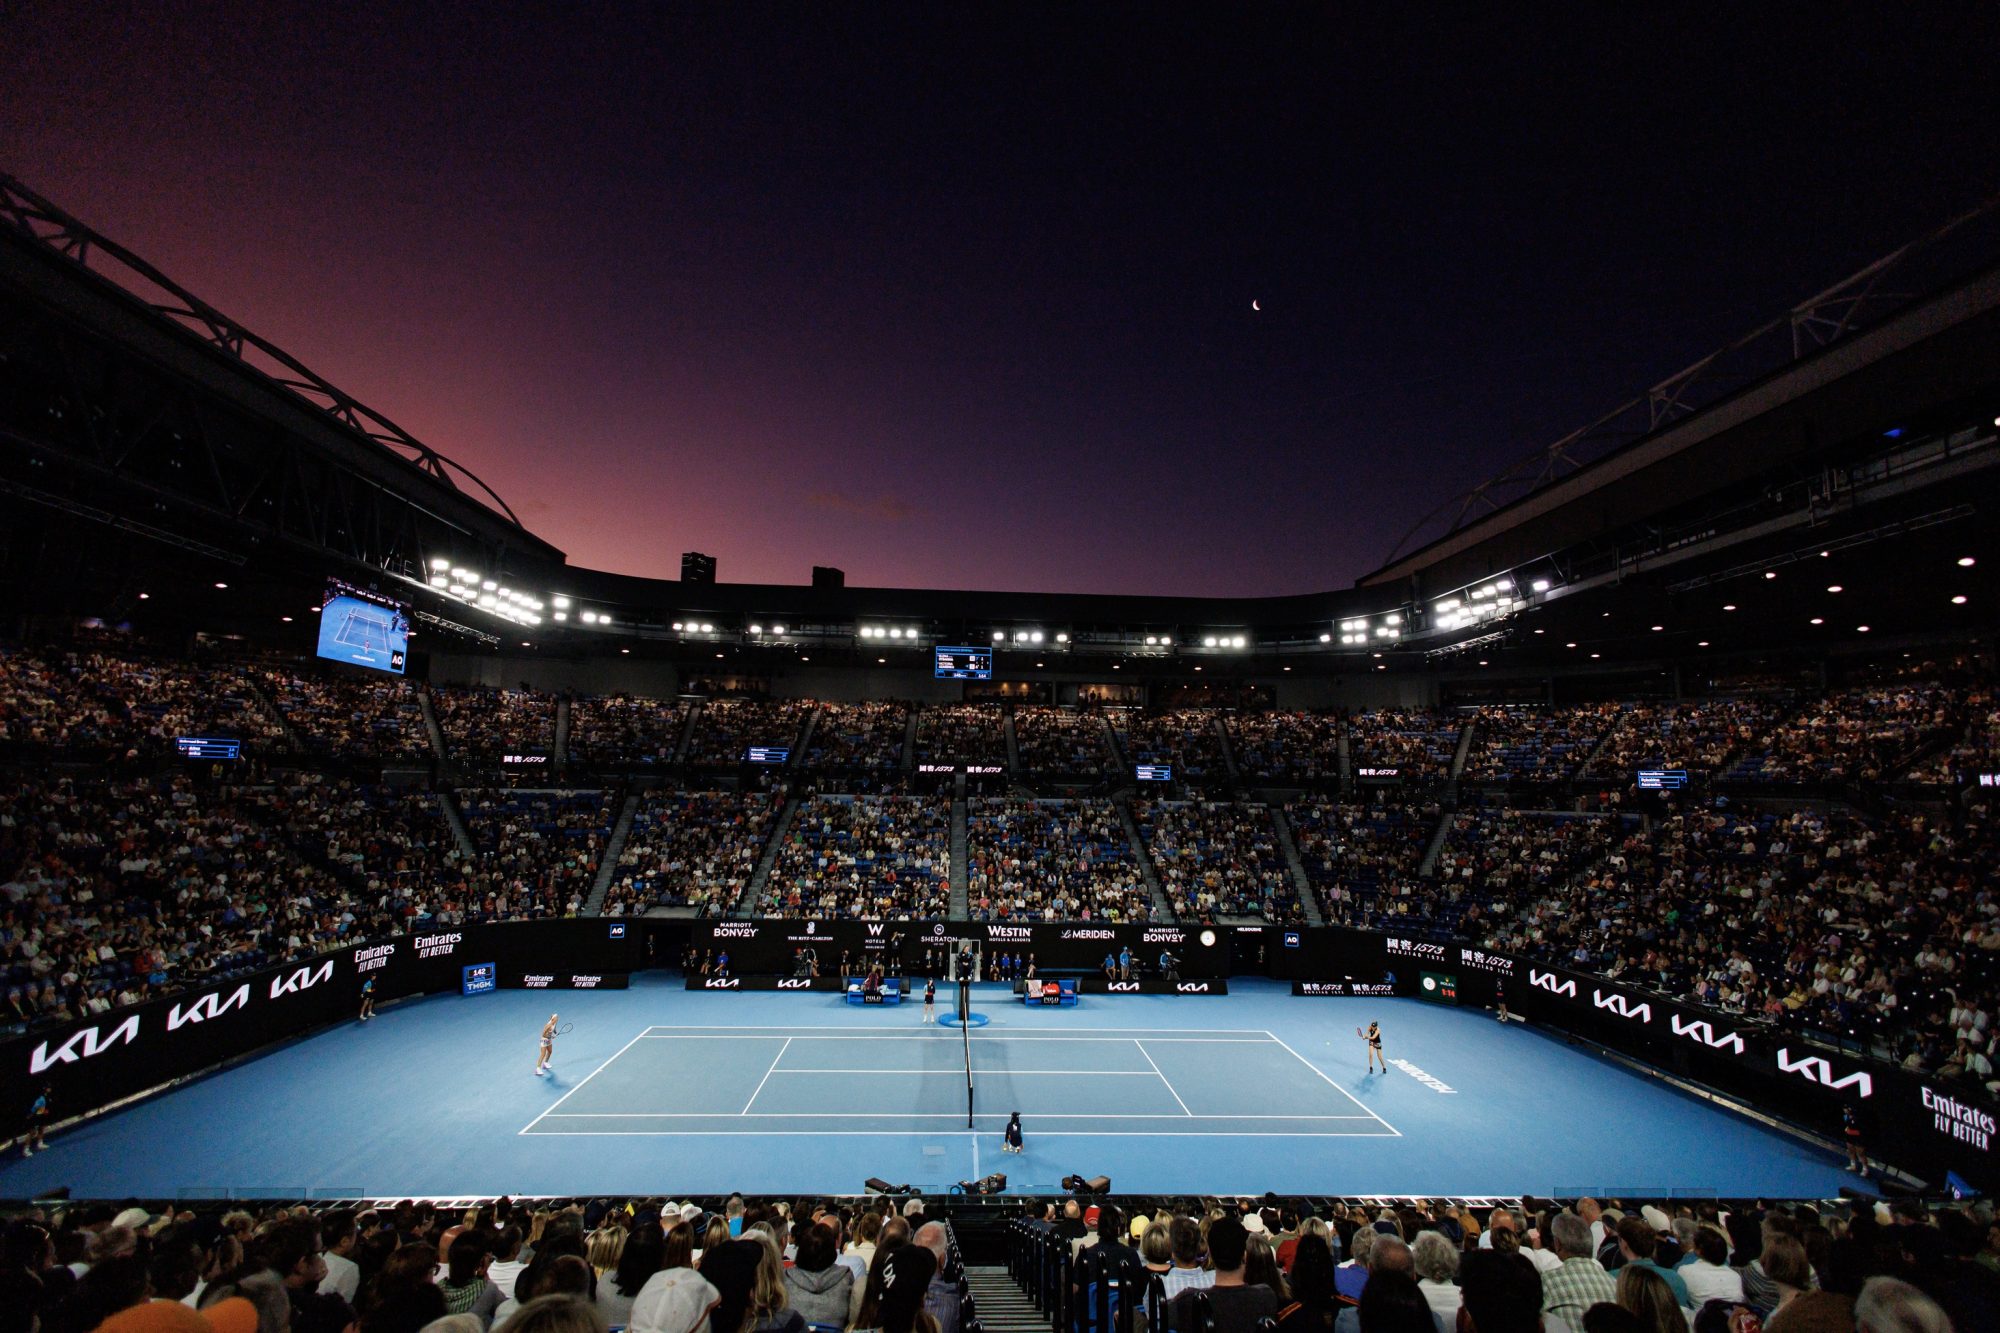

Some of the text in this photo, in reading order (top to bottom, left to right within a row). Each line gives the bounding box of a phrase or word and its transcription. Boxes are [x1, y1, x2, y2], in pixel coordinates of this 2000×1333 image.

[392, 655, 403, 665] AO
[713, 928, 759, 937] BONVOY
[868, 923, 884, 936] W
[987, 925, 1032, 937] WESTIN
[1060, 929, 1115, 939] Le MERIDIEN
[414, 932, 462, 949] Emirates
[1143, 933, 1186, 943] BONVOY
[354, 943, 395, 963] Emirates
[419, 944, 454, 959] FLY BETTER
[358, 956, 387, 973] FLY BETTER
[473, 967, 486, 976] 142
[270, 960, 334, 999] KIA
[524, 974, 553, 982] Emirates
[572, 974, 601, 982] Emirates
[705, 978, 740, 988] KIA
[777, 978, 811, 988] KIA
[1529, 968, 1576, 998] KIA
[1107, 981, 1140, 991] KIA
[1176, 982, 1208, 992] KIA
[168, 984, 250, 1031] KIA
[1593, 988, 1651, 1023] KIA
[1671, 1013, 1744, 1055] KIA
[30, 1015, 140, 1074] KIA
[1777, 1047, 1872, 1098] KIA
[1921, 1086, 1996, 1136] Emirates
[1934, 1113, 1989, 1151] FLY BETTER
